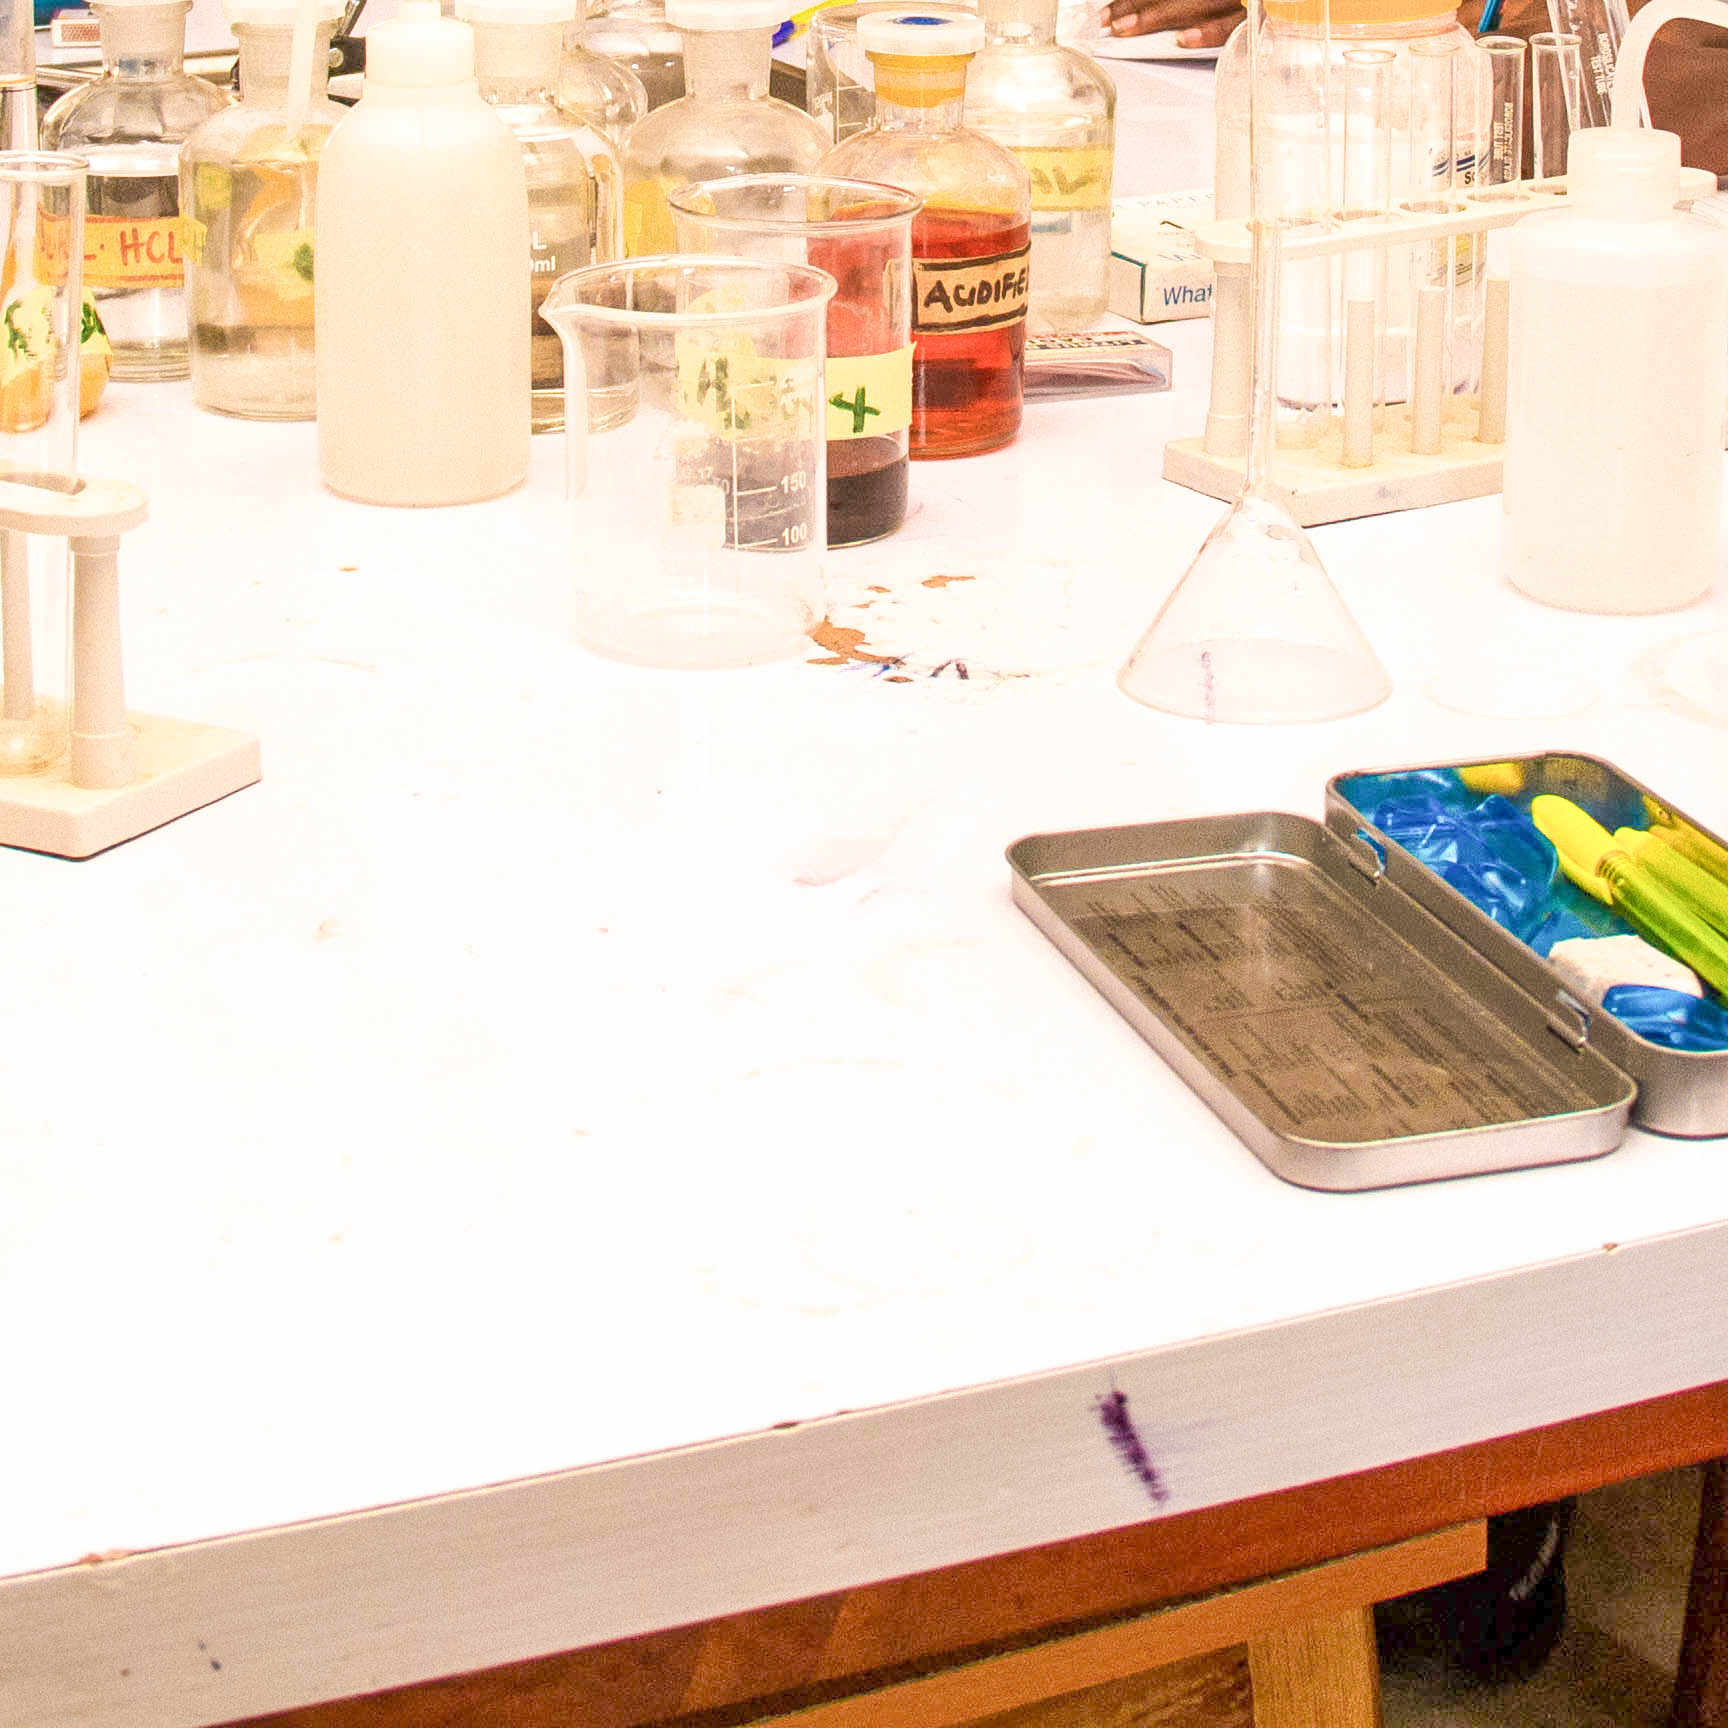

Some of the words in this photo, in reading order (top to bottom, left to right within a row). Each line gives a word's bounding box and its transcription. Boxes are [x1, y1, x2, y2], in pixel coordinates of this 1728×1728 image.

[923, 266, 1029, 313] ACIDIFIE
[780, 470, 807, 494] 150
[781, 522, 808, 546] 100
